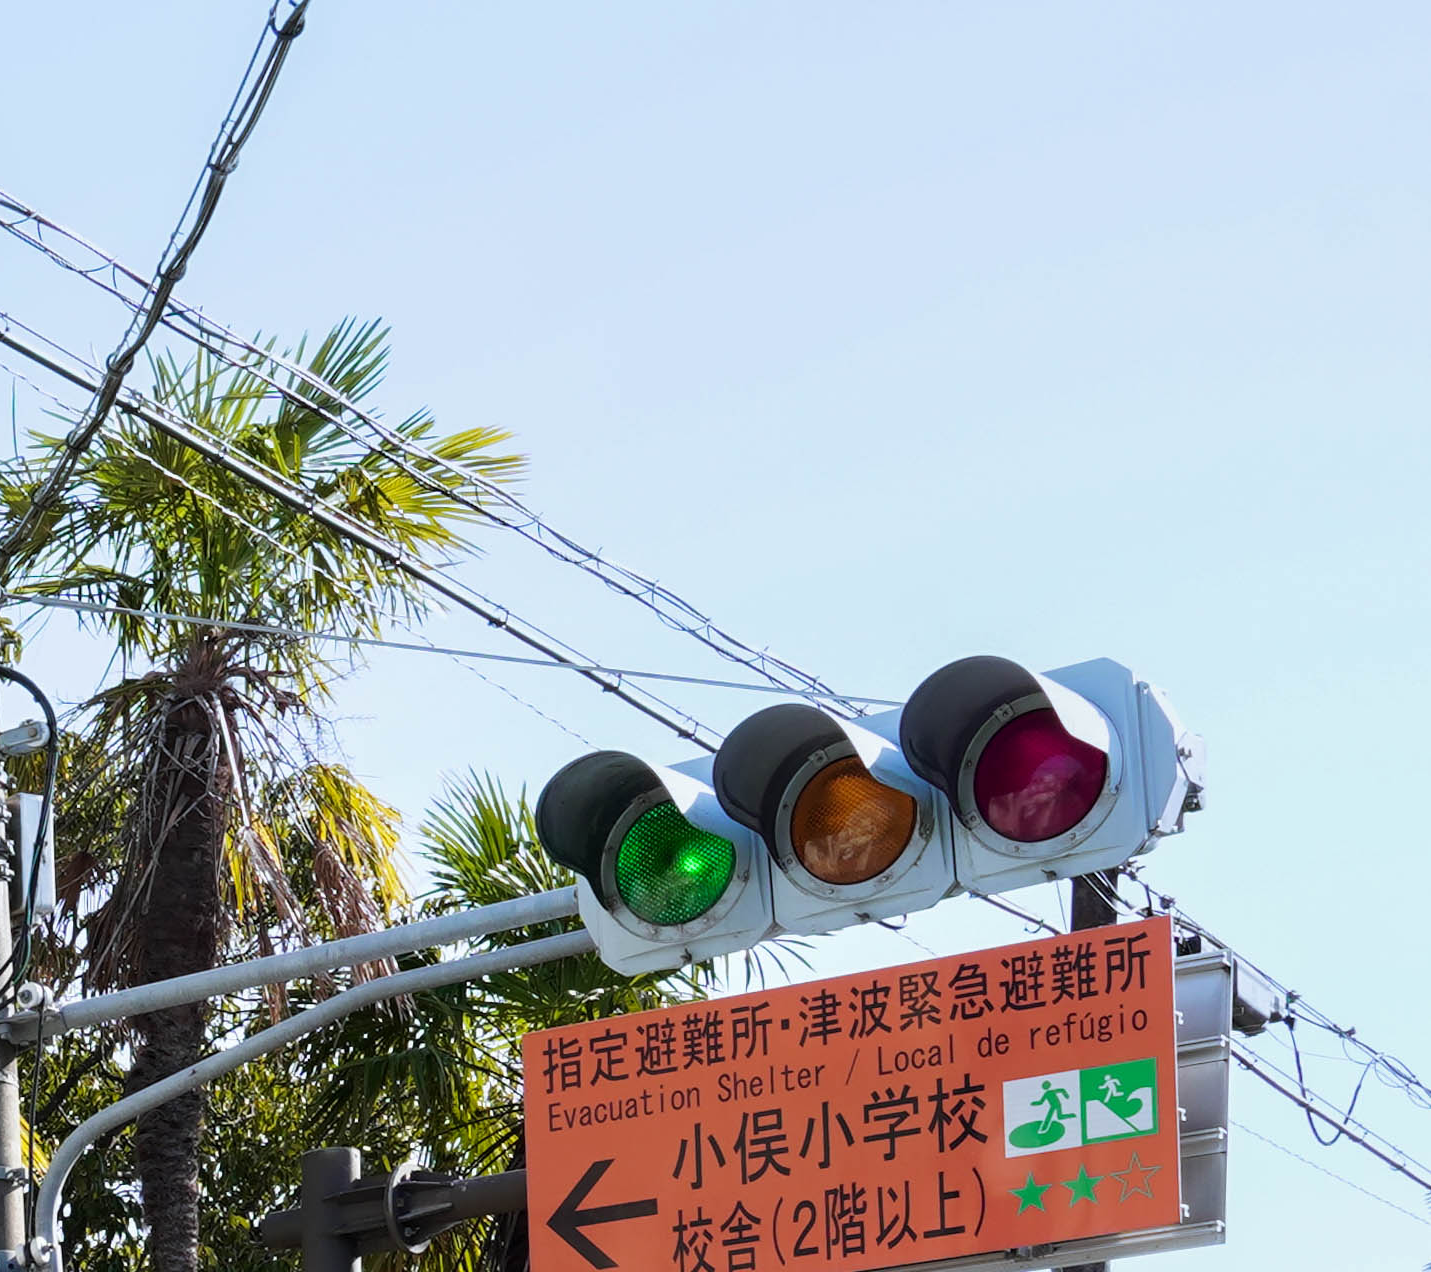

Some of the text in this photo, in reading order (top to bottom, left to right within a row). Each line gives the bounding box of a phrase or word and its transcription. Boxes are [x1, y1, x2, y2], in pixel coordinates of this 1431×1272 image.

[541, 930, 1150, 1095] 指定避難所・津波緊急避難所
[549, 1009, 1149, 1133] Evacuation Shelter / Local de refúgio
[671, 1073, 989, 1191] 小俣小学校
